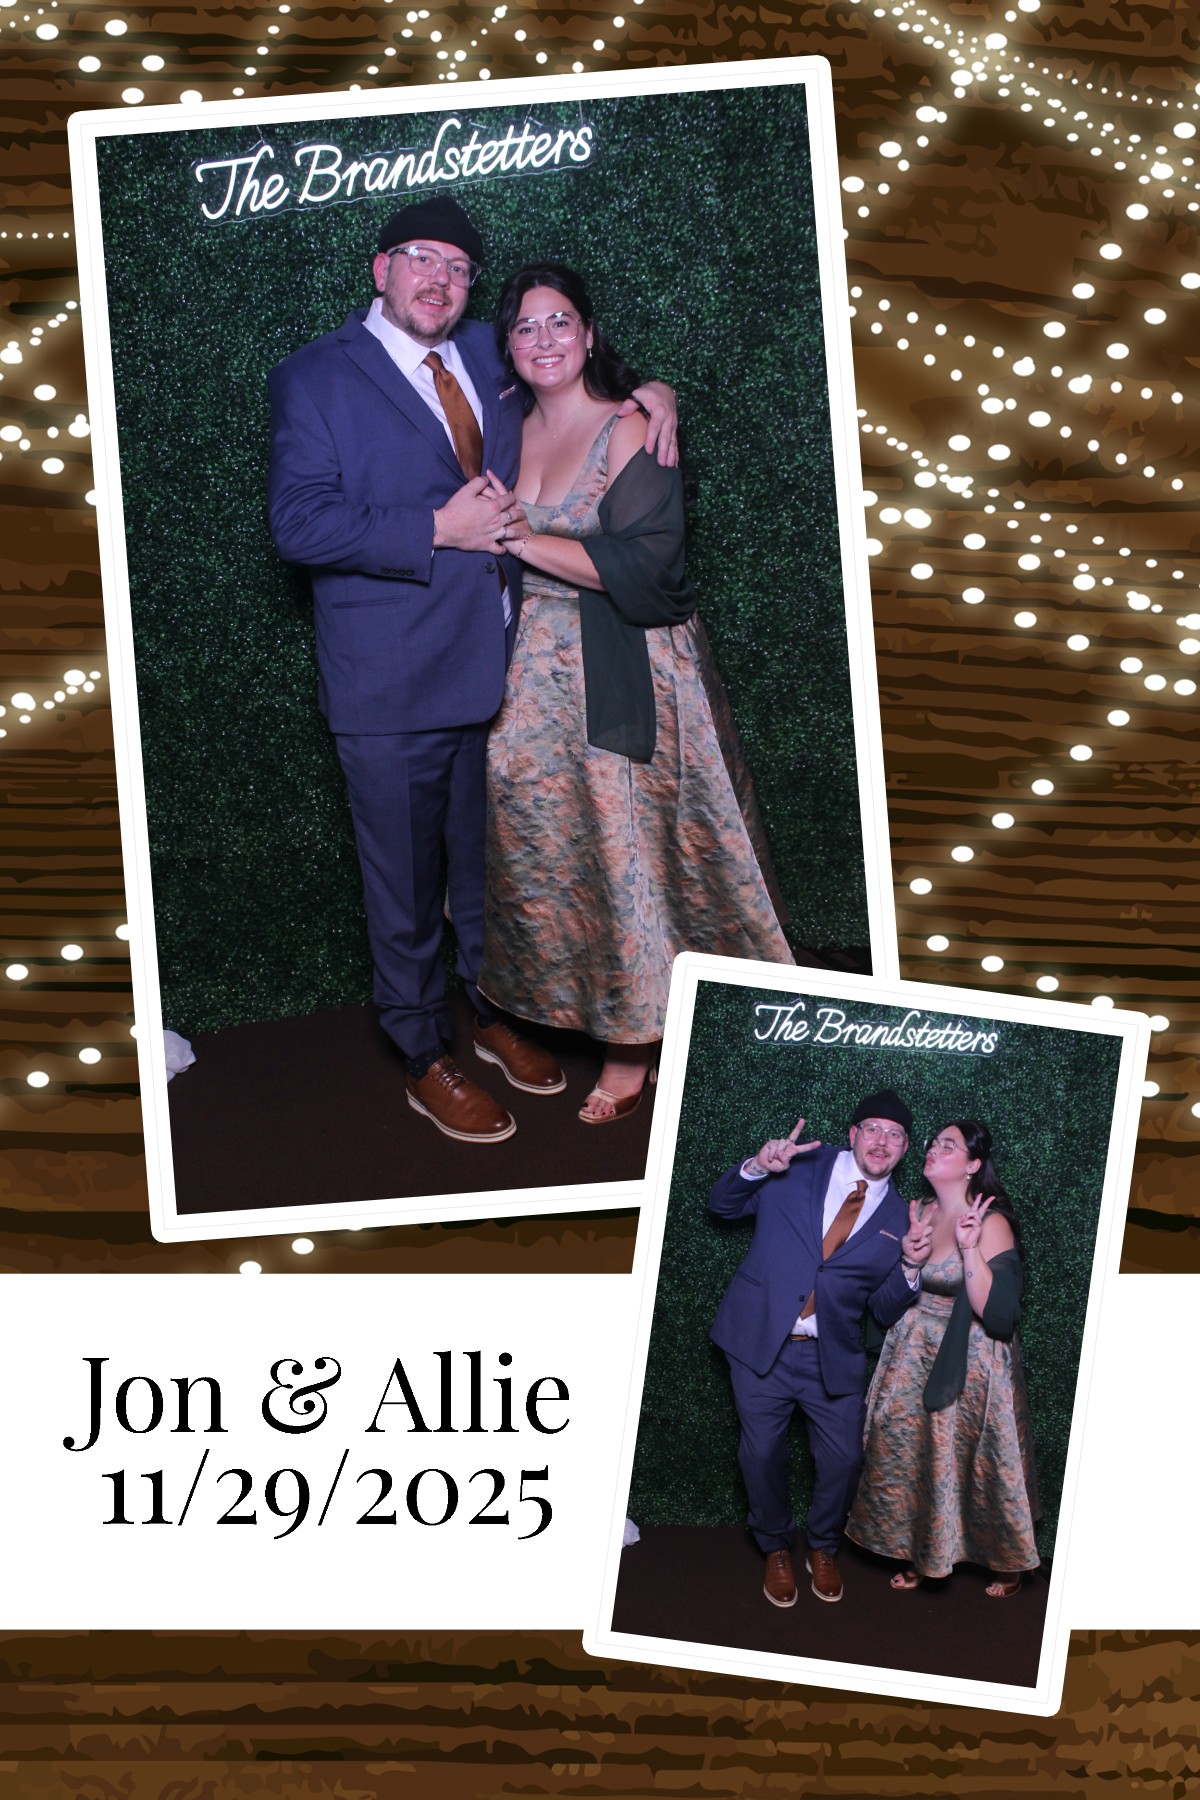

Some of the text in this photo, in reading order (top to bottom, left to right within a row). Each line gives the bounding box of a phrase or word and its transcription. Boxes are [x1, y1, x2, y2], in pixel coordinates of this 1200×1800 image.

[195, 118, 593, 220] The Brandstetters
[754, 1001, 999, 1054] The Brandstetters
